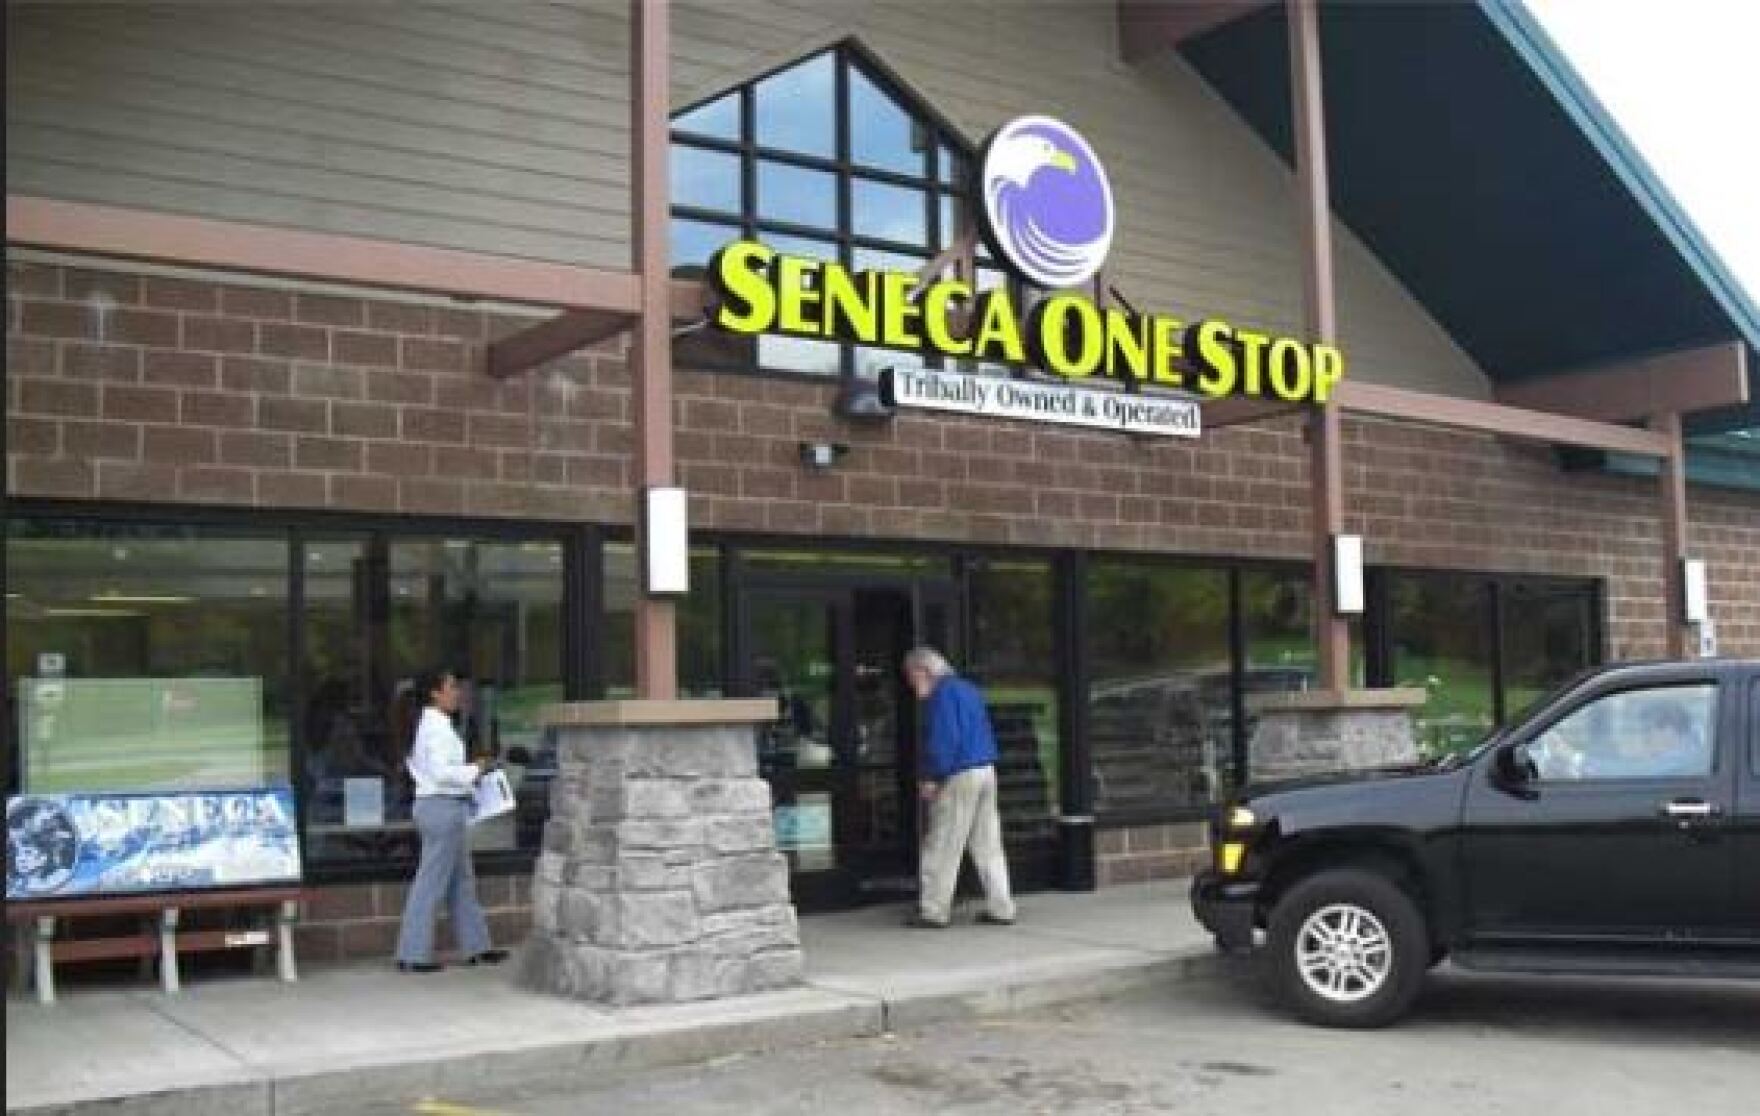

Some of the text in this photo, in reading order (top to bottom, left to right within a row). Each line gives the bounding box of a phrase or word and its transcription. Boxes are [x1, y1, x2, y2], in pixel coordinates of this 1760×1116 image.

[718, 240, 1345, 402] SENECA ONE STOP
[899, 371, 1199, 431] Tribally Owned & Operated
